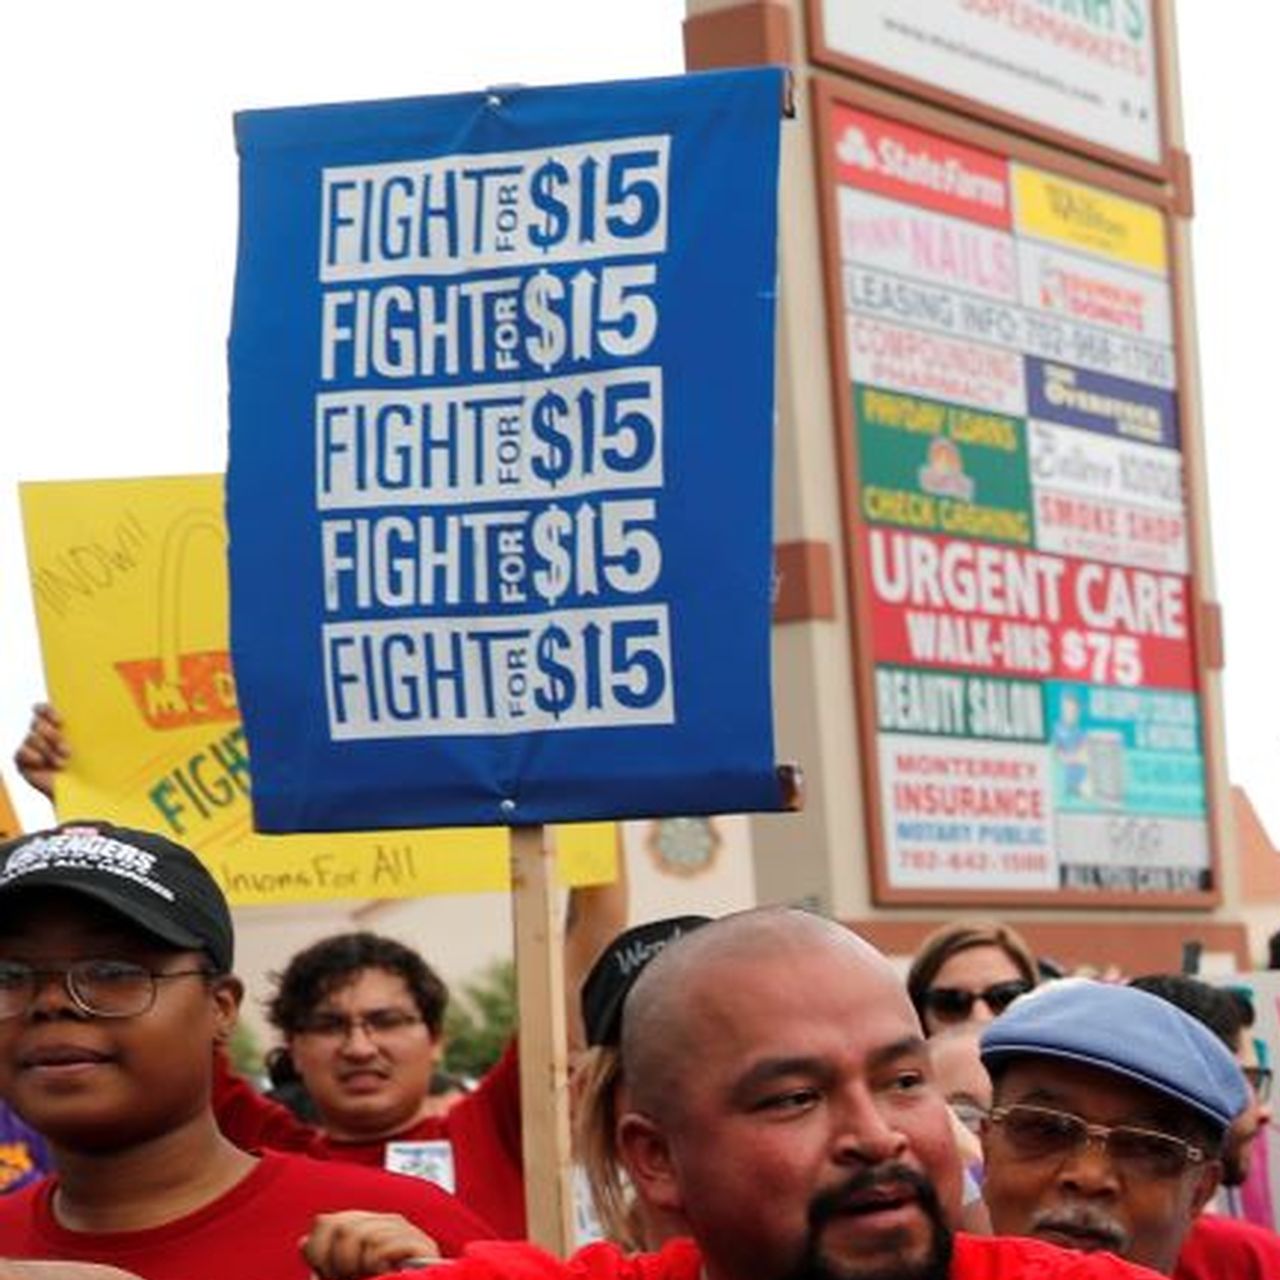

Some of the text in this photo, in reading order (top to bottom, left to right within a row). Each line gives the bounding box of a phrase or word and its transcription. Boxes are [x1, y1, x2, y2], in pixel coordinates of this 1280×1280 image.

[328, 150, 660, 265] FIGHT FOR $15
[322, 264, 659, 380] FIGHT FOR $15
[850, 274, 951, 328] LEASING
[322, 383, 655, 493] FIGHT FOR $15
[322, 500, 661, 611] FIGHT FOR $15
[870, 530, 1185, 638] URGENT CARE
[329, 620, 665, 723] FIGHT FOR $15
[907, 612, 1142, 687] WALK-INS $75
[149, 726, 251, 835] FIGH
[895, 783, 1041, 819] INSURANCE
[897, 821, 971, 842] NOTARY
[312, 853, 358, 886] For
[374, 846, 416, 882] All
